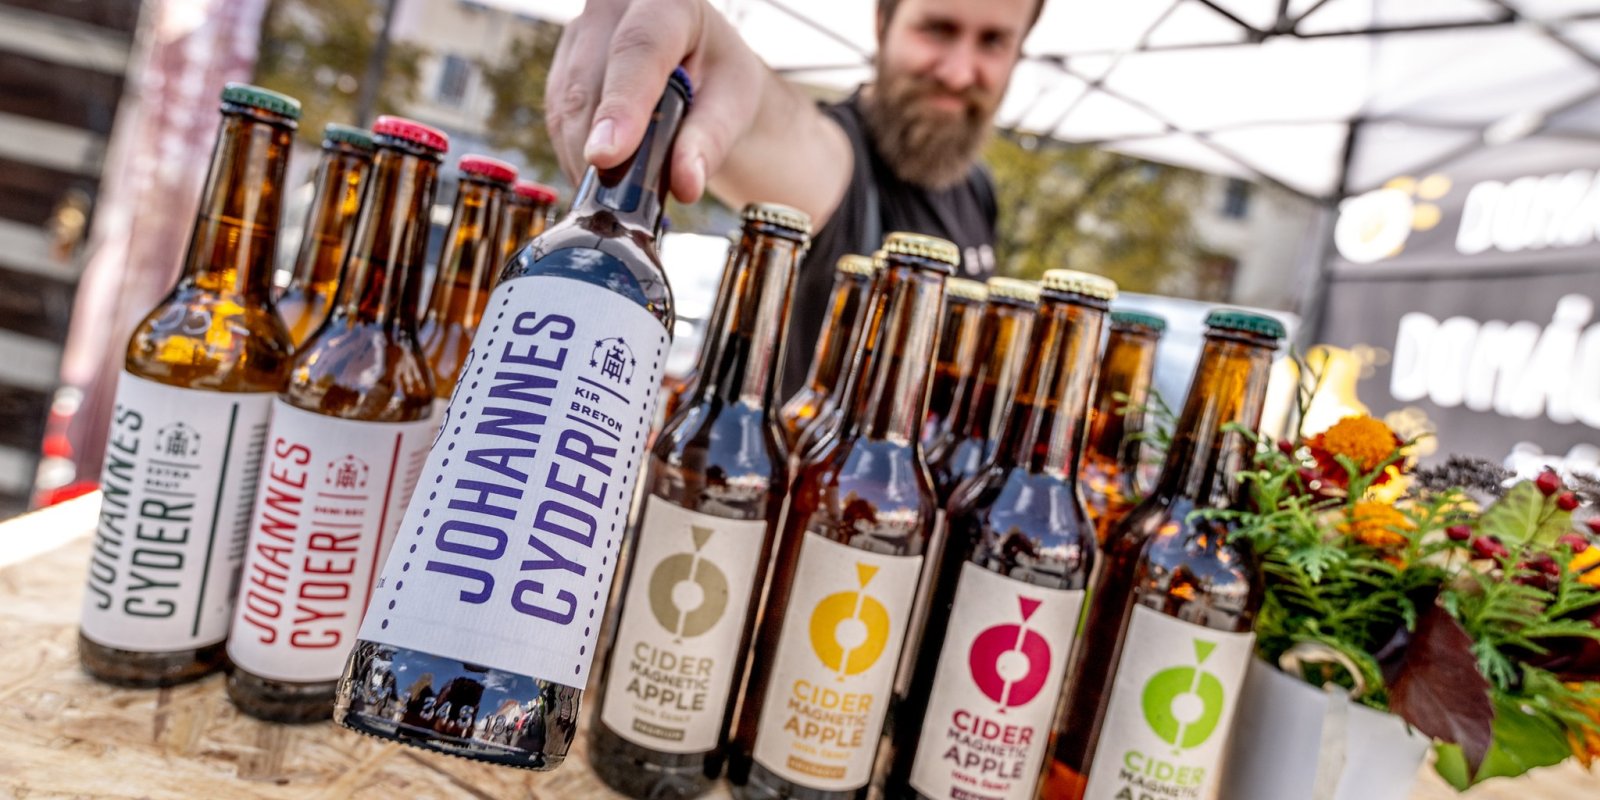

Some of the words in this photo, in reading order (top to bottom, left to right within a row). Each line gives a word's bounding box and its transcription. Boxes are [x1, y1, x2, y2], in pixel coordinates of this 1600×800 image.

[574, 386, 600, 404] KIR
[570, 402, 623, 432] BRETON
[425, 311, 577, 604] JOHANNES
[88, 404, 145, 612] JOHANNES
[243, 437, 312, 646] JOHANNES
[511, 428, 619, 625] CYDER
[124, 497, 196, 621] CYDER
[289, 531, 361, 651] CYDER
[629, 661, 710, 690] MAGNETIC
[634, 641, 713, 677] CIDER
[626, 677, 706, 711] APPLE
[792, 679, 873, 713] CIDER
[787, 699, 868, 728] MAGNETIC
[952, 708, 1034, 745] CIDER
[784, 718, 863, 748] APPLE
[946, 726, 1027, 759] MAGNETIC
[942, 744, 1024, 779] APPLE
[1123, 748, 1206, 786] CIDER
[1118, 766, 1199, 798] MAGNETIC
